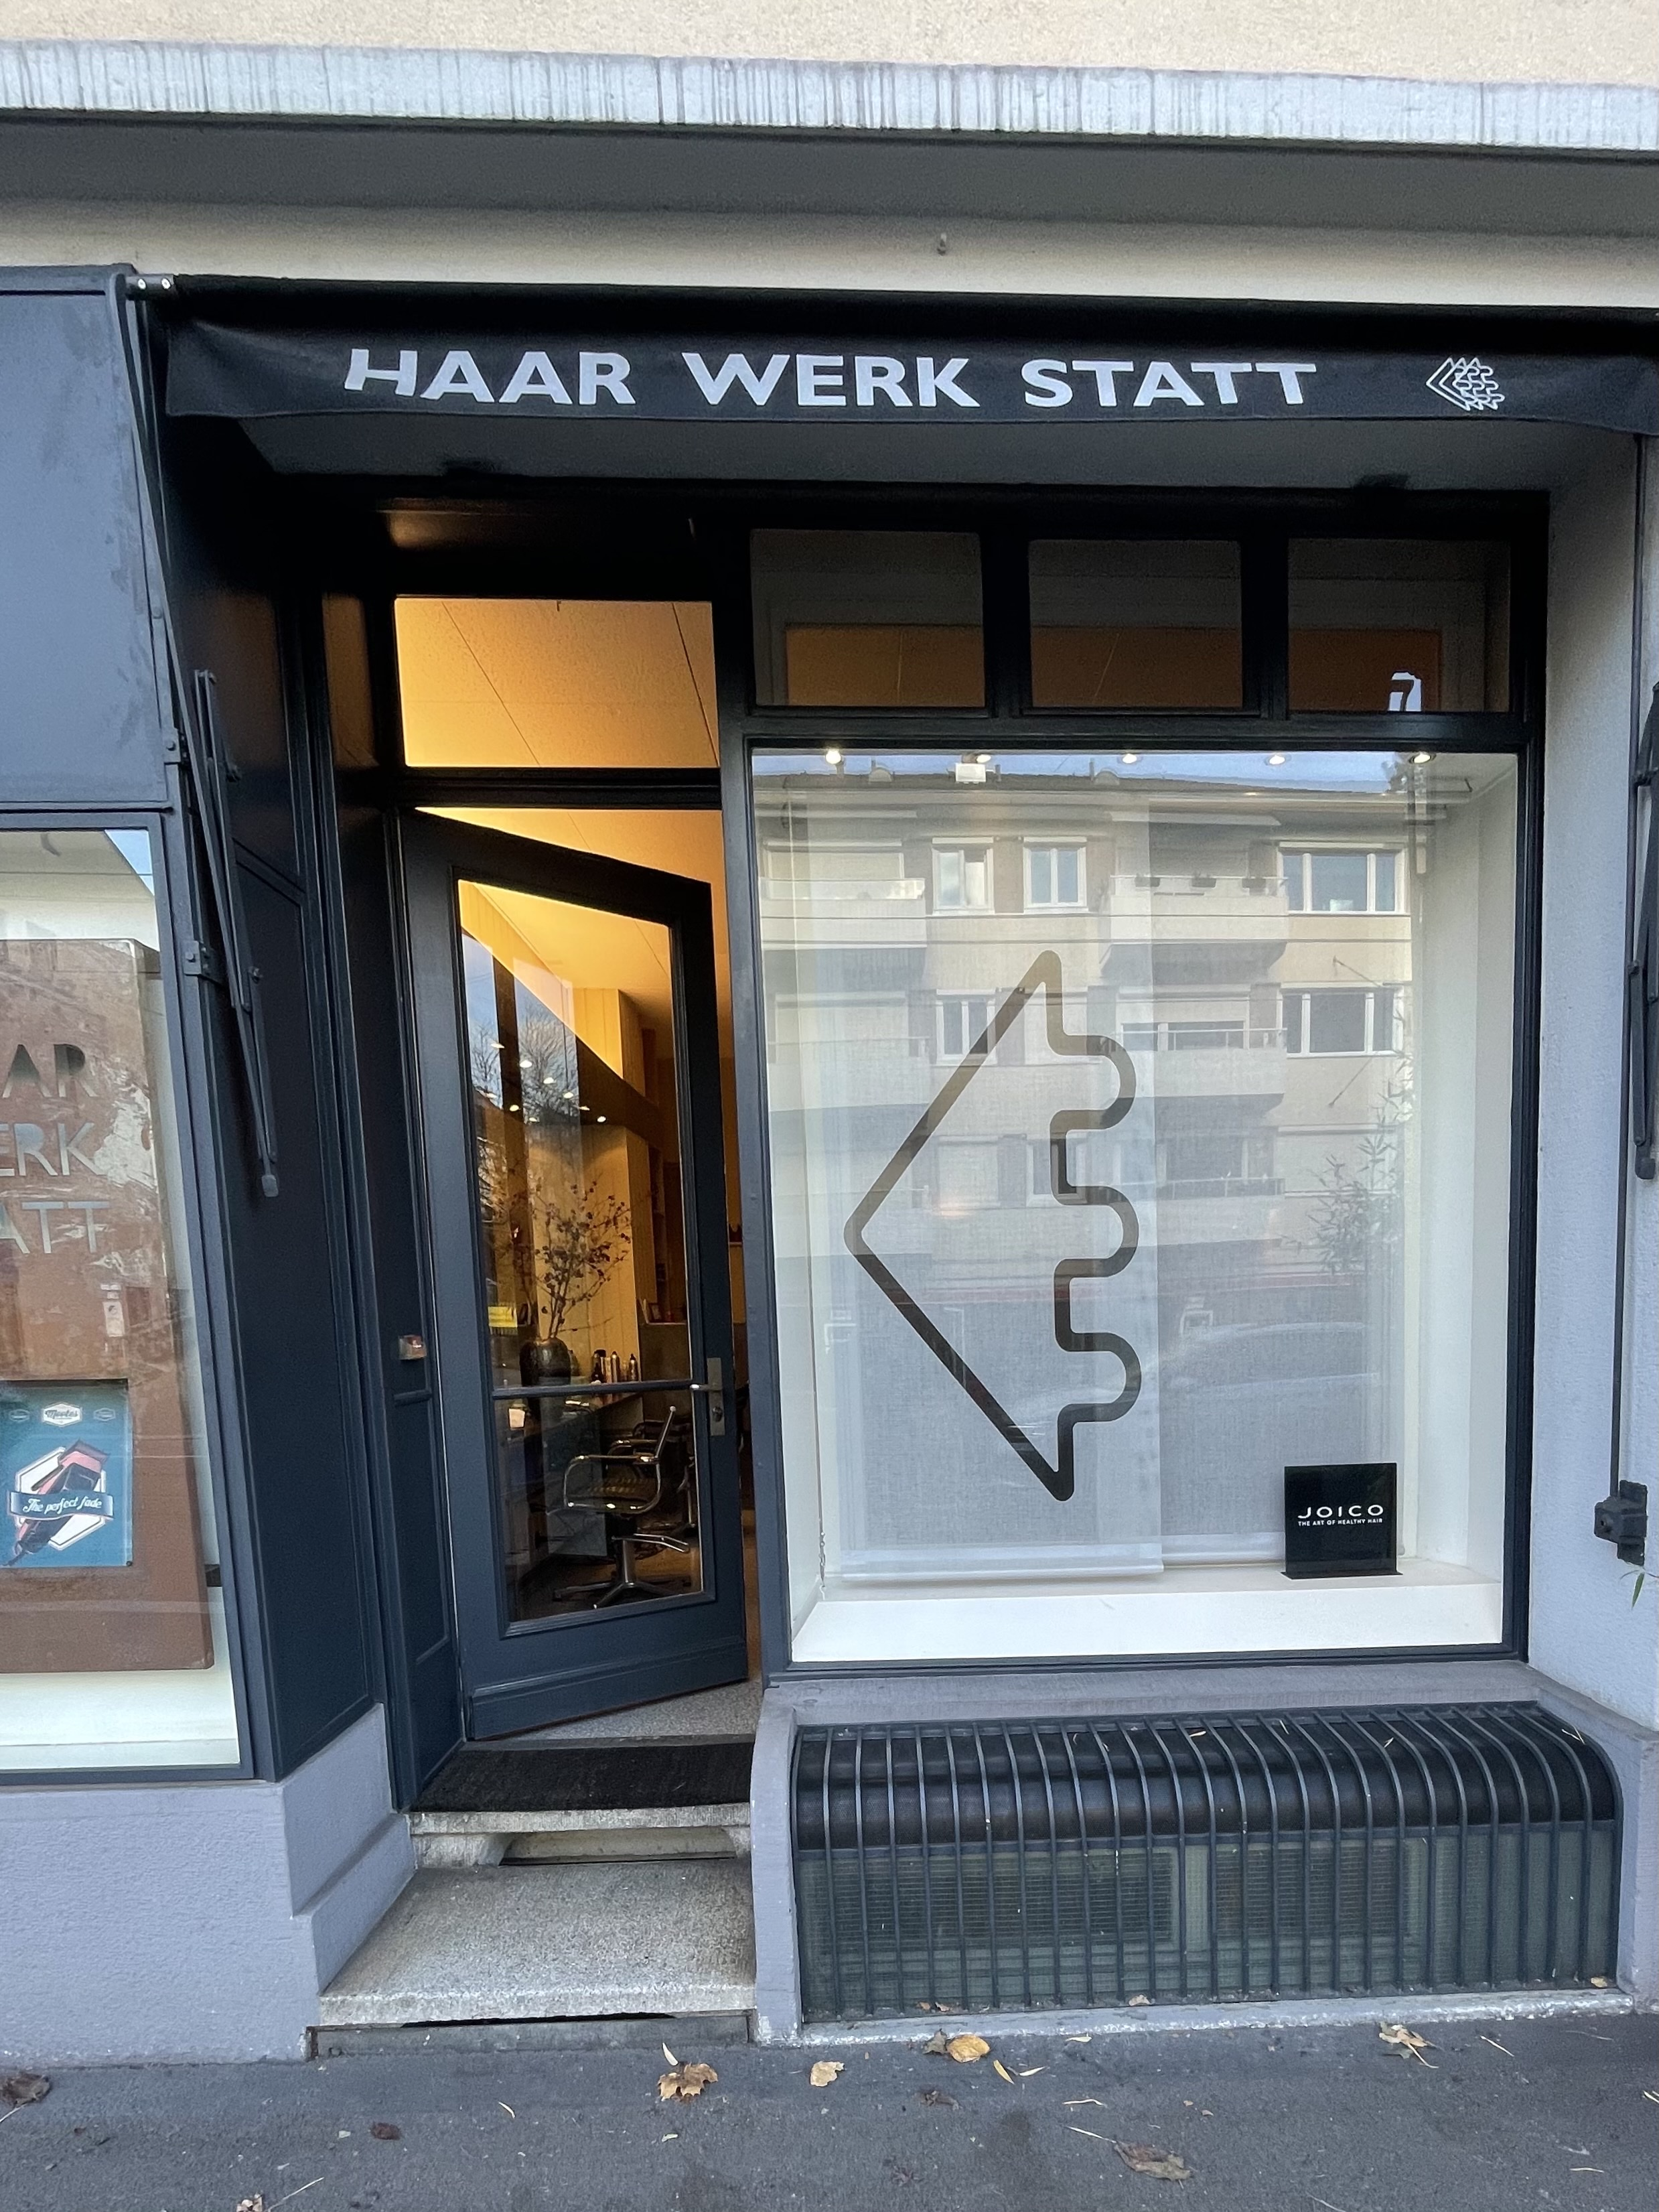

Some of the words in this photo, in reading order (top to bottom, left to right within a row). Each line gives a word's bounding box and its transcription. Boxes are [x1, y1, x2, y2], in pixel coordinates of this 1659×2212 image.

[344, 348, 636, 405] HAAR
[682, 352, 981, 408] WERK
[1024, 358, 1317, 407] STATT
[22, 1498, 44, 1513] The
[44, 1497, 79, 1515] perfect
[76, 1496, 102, 1510] fade
[1297, 1505, 1384, 1519] JOICO
